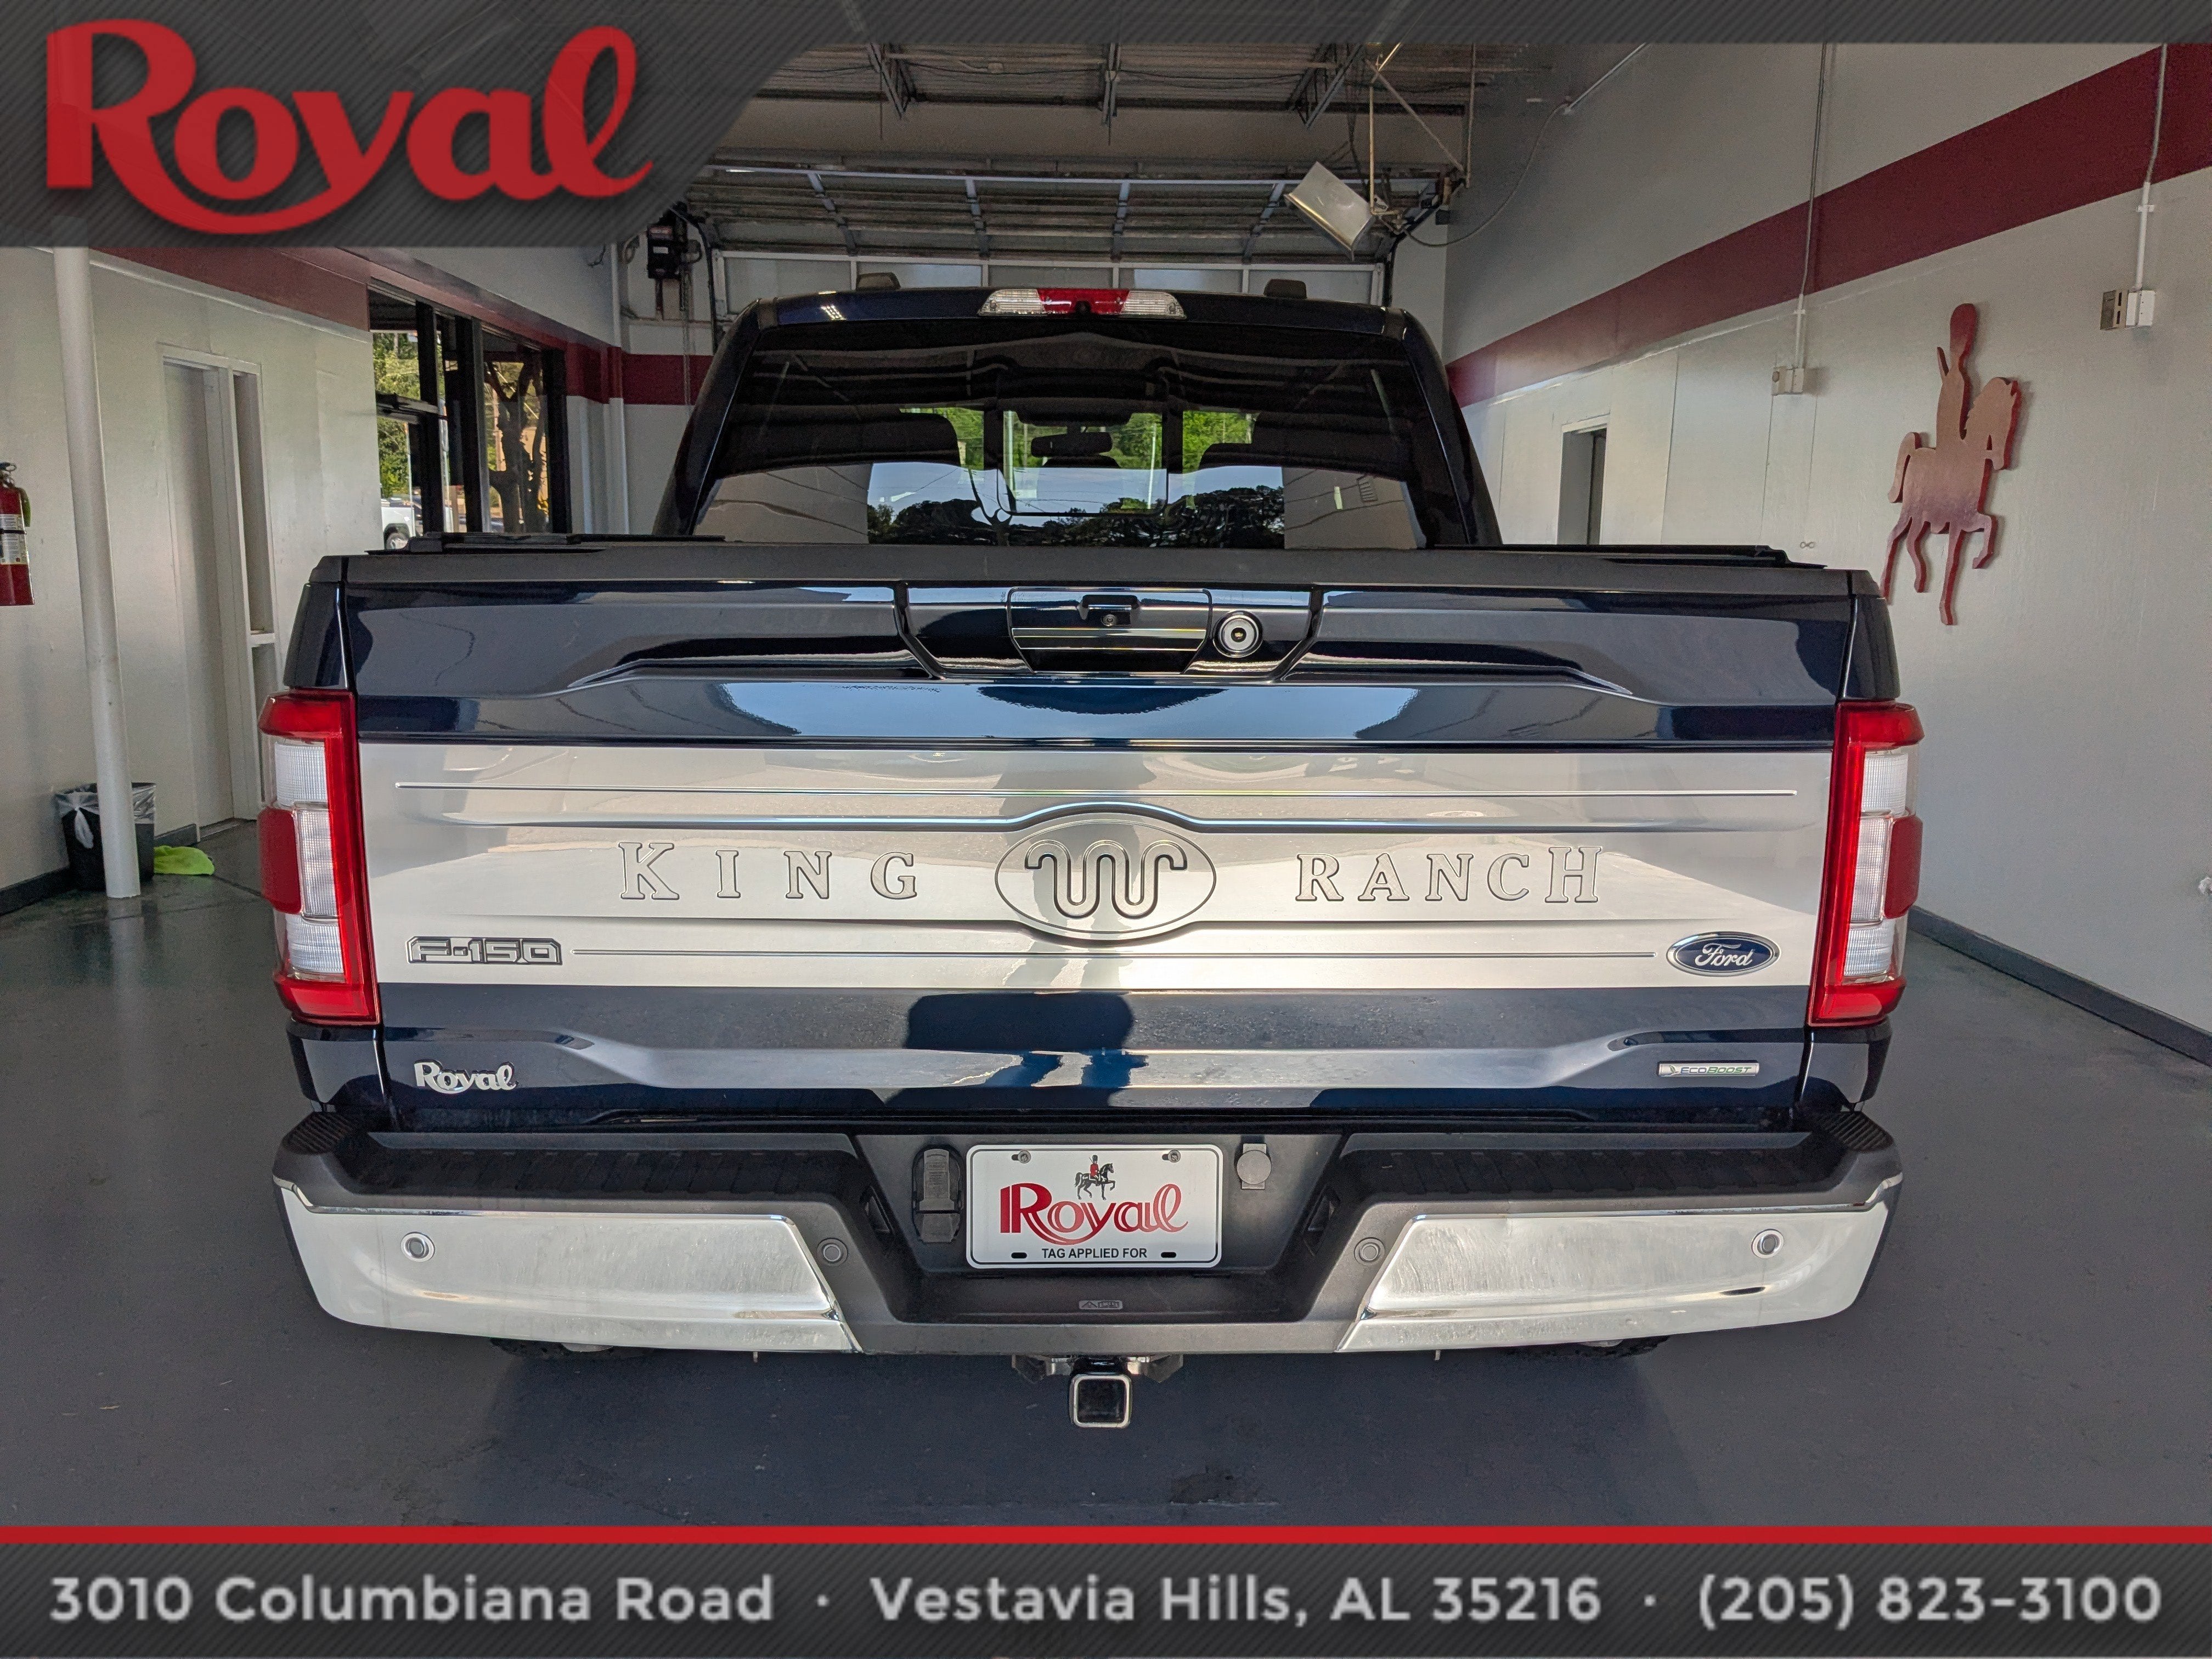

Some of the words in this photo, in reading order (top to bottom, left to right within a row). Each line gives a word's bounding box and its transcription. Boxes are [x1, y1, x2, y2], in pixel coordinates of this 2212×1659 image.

[618, 842, 918, 900] KING
[1295, 846, 1603, 904] RANCH
[406, 936, 563, 965] F-150
[1695, 942, 1755, 967] Ford
[414, 1059, 519, 1094] Royal
[1000, 1182, 1189, 1245] Royal
[1041, 1248, 1065, 1259] TAG
[1068, 1248, 1119, 1259] APPLIED
[1122, 1248, 1147, 1259] FOR
